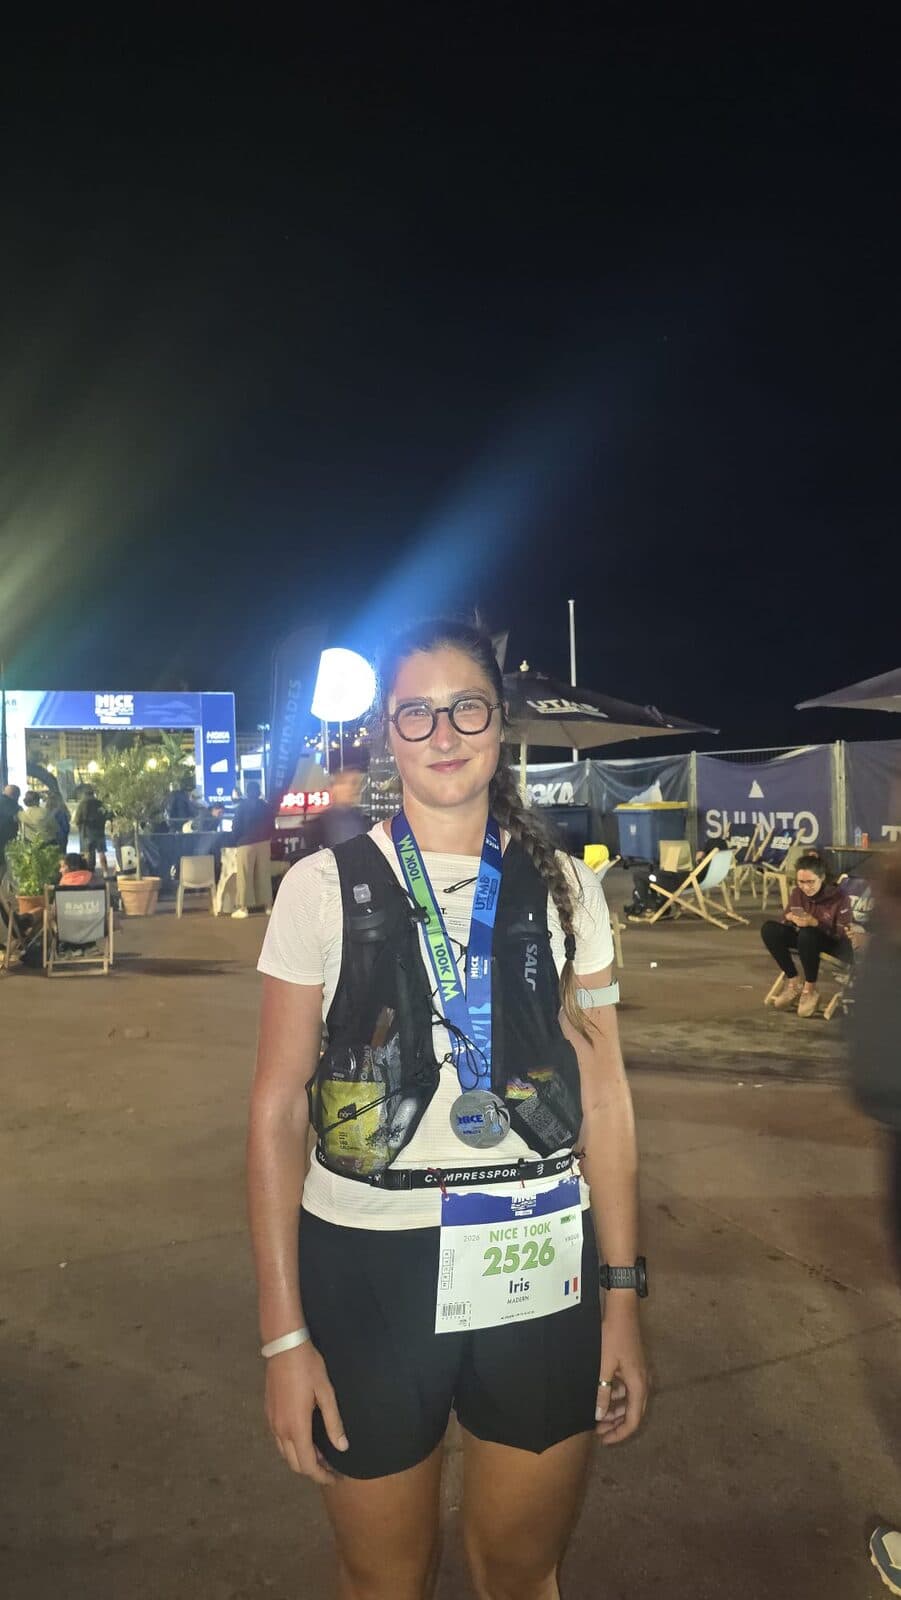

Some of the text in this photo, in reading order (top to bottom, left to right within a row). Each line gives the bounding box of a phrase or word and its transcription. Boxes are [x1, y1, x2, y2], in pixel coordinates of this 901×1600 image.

[526, 782, 574, 804] OKA
[405, 853, 421, 881] 100K
[475, 876, 490, 910] UTMB
[433, 943, 451, 975] 100K
[425, 1169, 519, 1184] CMPRESSPOR
[489, 1227, 518, 1243] NICE
[524, 1220, 551, 1237] 100K
[482, 1238, 555, 1277] 2526
[509, 1278, 530, 1294] Iris
[507, 1296, 530, 1305] MADERN
